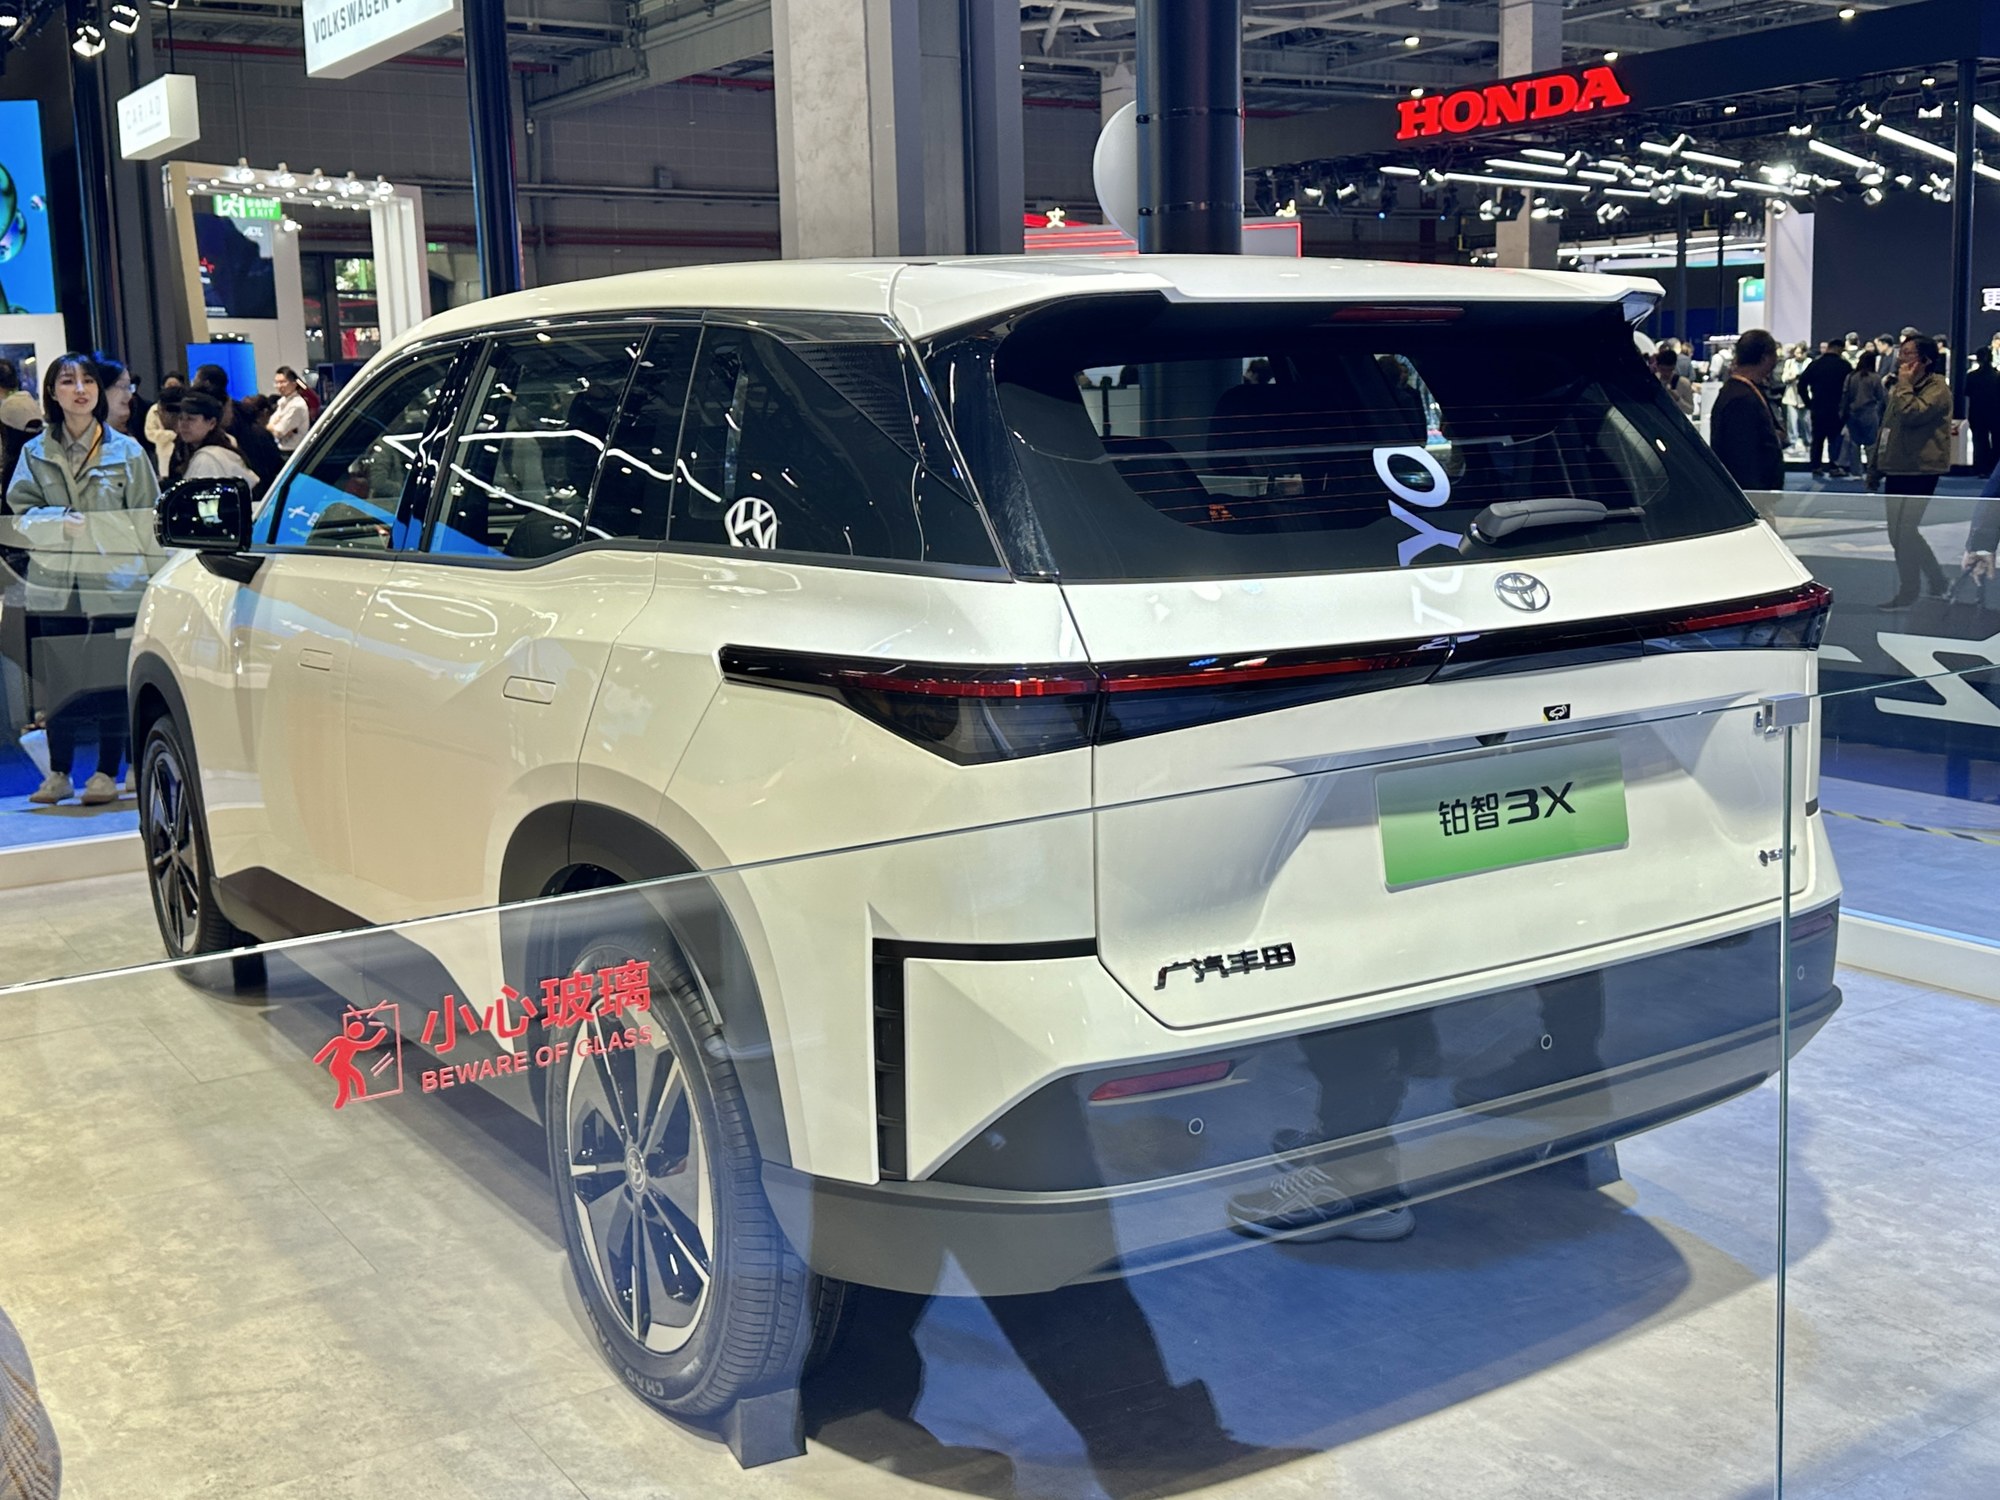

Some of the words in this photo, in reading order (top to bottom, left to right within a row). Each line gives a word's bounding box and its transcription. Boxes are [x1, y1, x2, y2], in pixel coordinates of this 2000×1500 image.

[1397, 66, 1630, 140] HONDA
[1438, 781, 1576, 837] 铂智3X
[1154, 942, 1296, 991] 广汽丰田
[420, 959, 652, 1054] 小心玻璃
[422, 1050, 529, 1093] BEWARE
[535, 1042, 569, 1067] OF
[577, 1025, 653, 1058] GLASS
